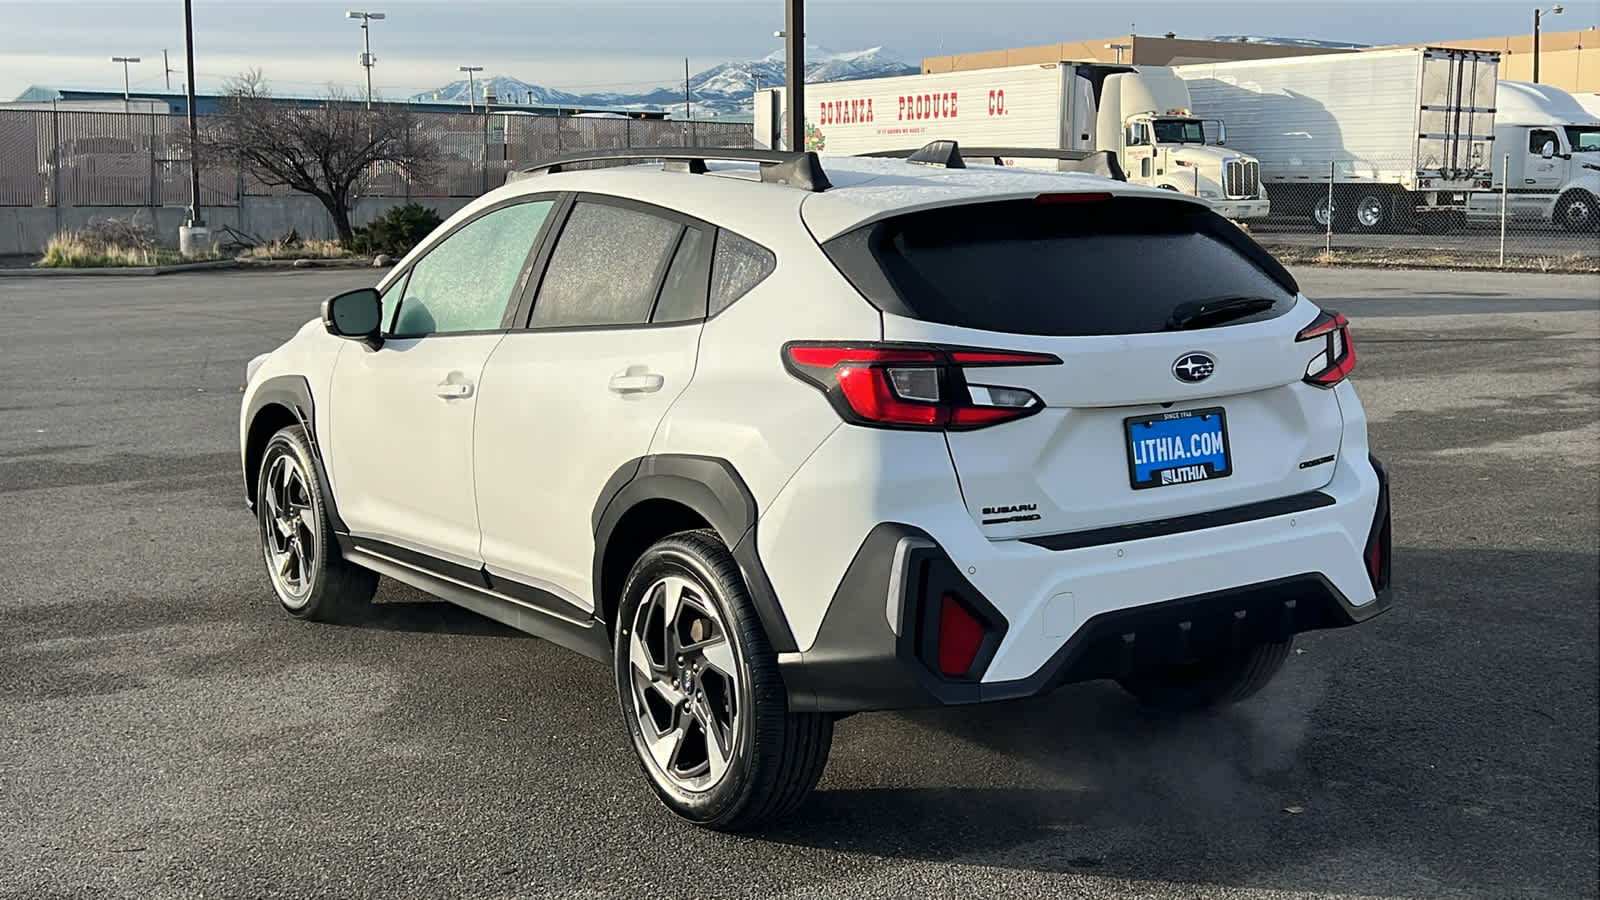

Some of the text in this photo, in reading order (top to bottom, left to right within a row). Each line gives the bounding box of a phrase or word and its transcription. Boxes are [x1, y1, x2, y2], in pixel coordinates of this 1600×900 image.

[820, 89, 1008, 125] BONANZA PRODUCE CO.
[1163, 412, 1180, 420] SINCE
[1132, 430, 1224, 465] LITHIA.COM
[1171, 465, 1208, 483] LITHIA
[982, 503, 1037, 514] SUBARU
